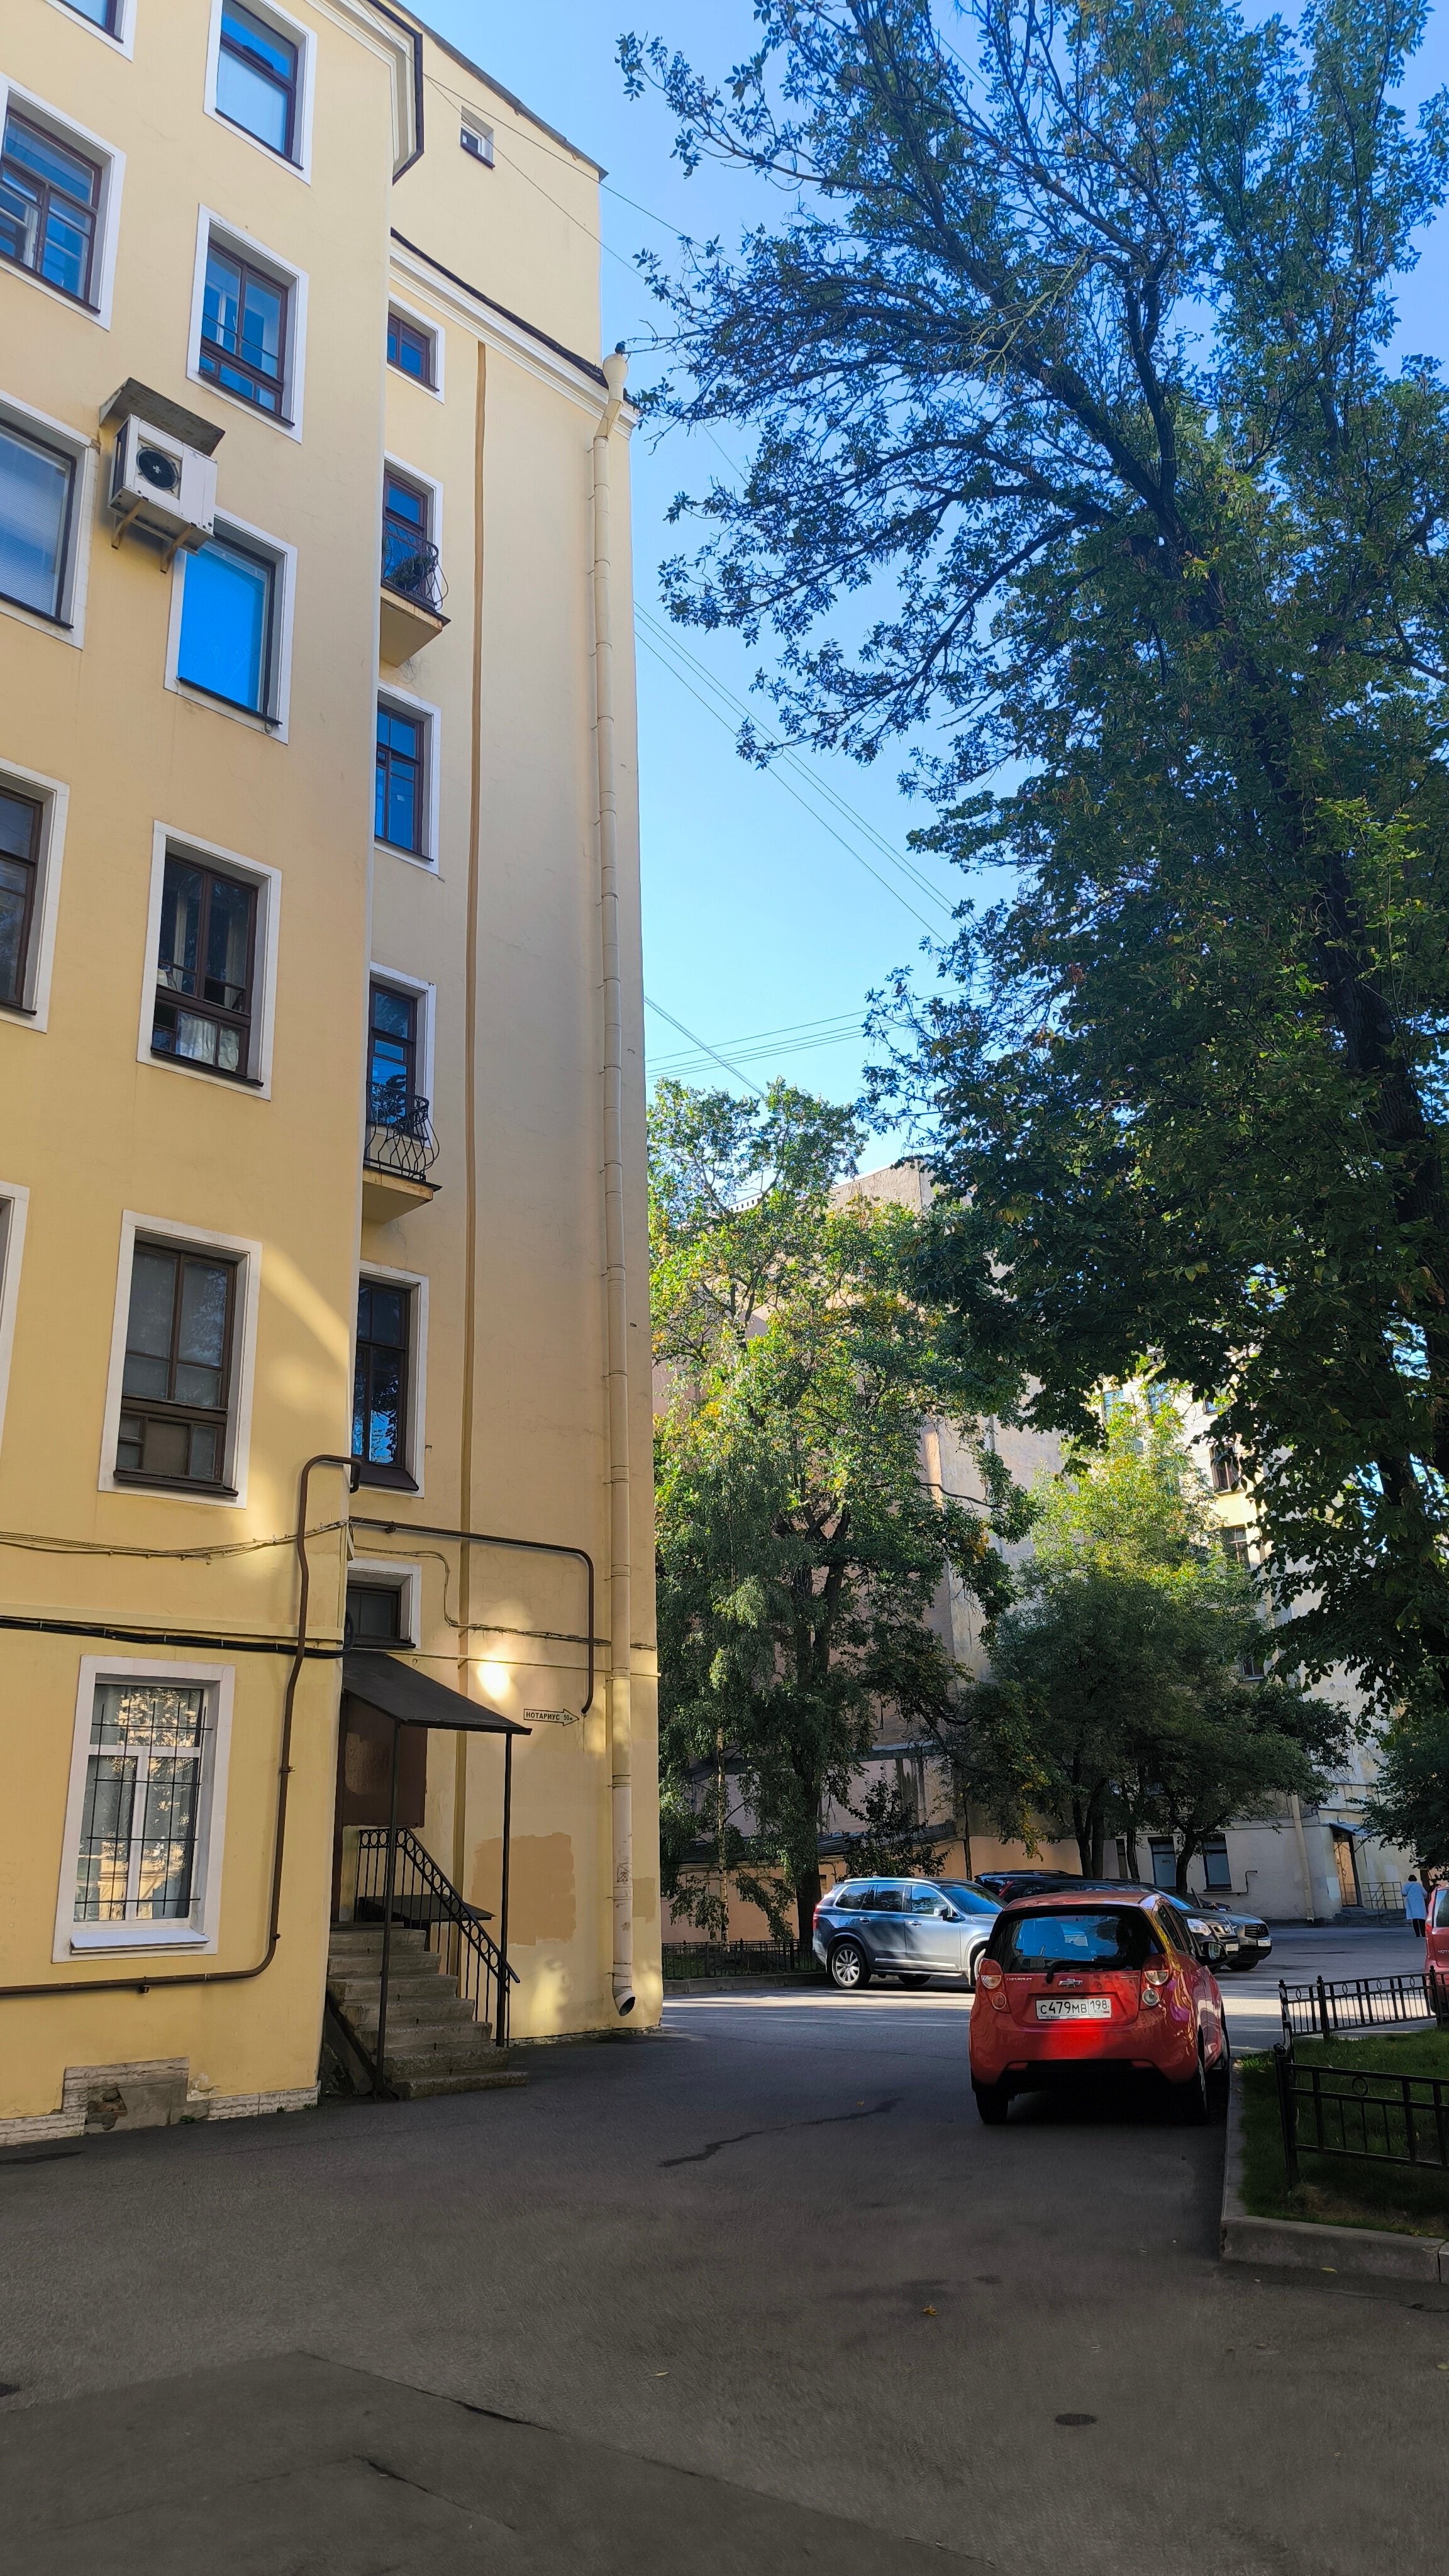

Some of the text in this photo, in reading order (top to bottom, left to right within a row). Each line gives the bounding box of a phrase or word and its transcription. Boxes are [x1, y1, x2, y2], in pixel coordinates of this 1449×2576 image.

[526, 1711, 560, 1721] НОТАРИУС
[1040, 2000, 1108, 2014] С479МВ 198
